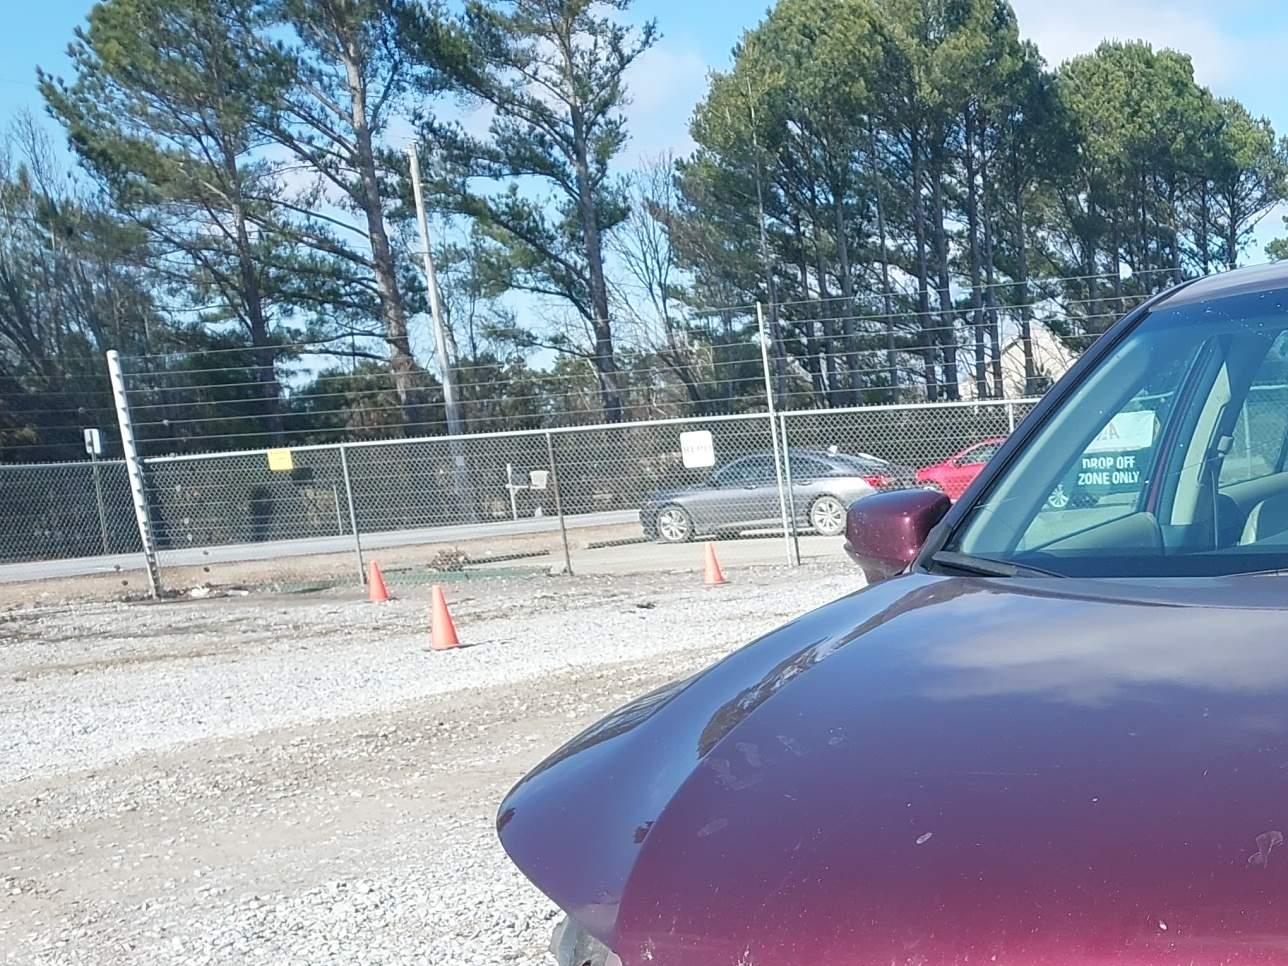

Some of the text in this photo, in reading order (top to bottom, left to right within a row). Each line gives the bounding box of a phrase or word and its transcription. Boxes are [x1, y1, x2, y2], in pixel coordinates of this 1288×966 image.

[1082, 456, 1136, 469] DROP OFF
[1078, 471, 1140, 485] ZONE ONLY
